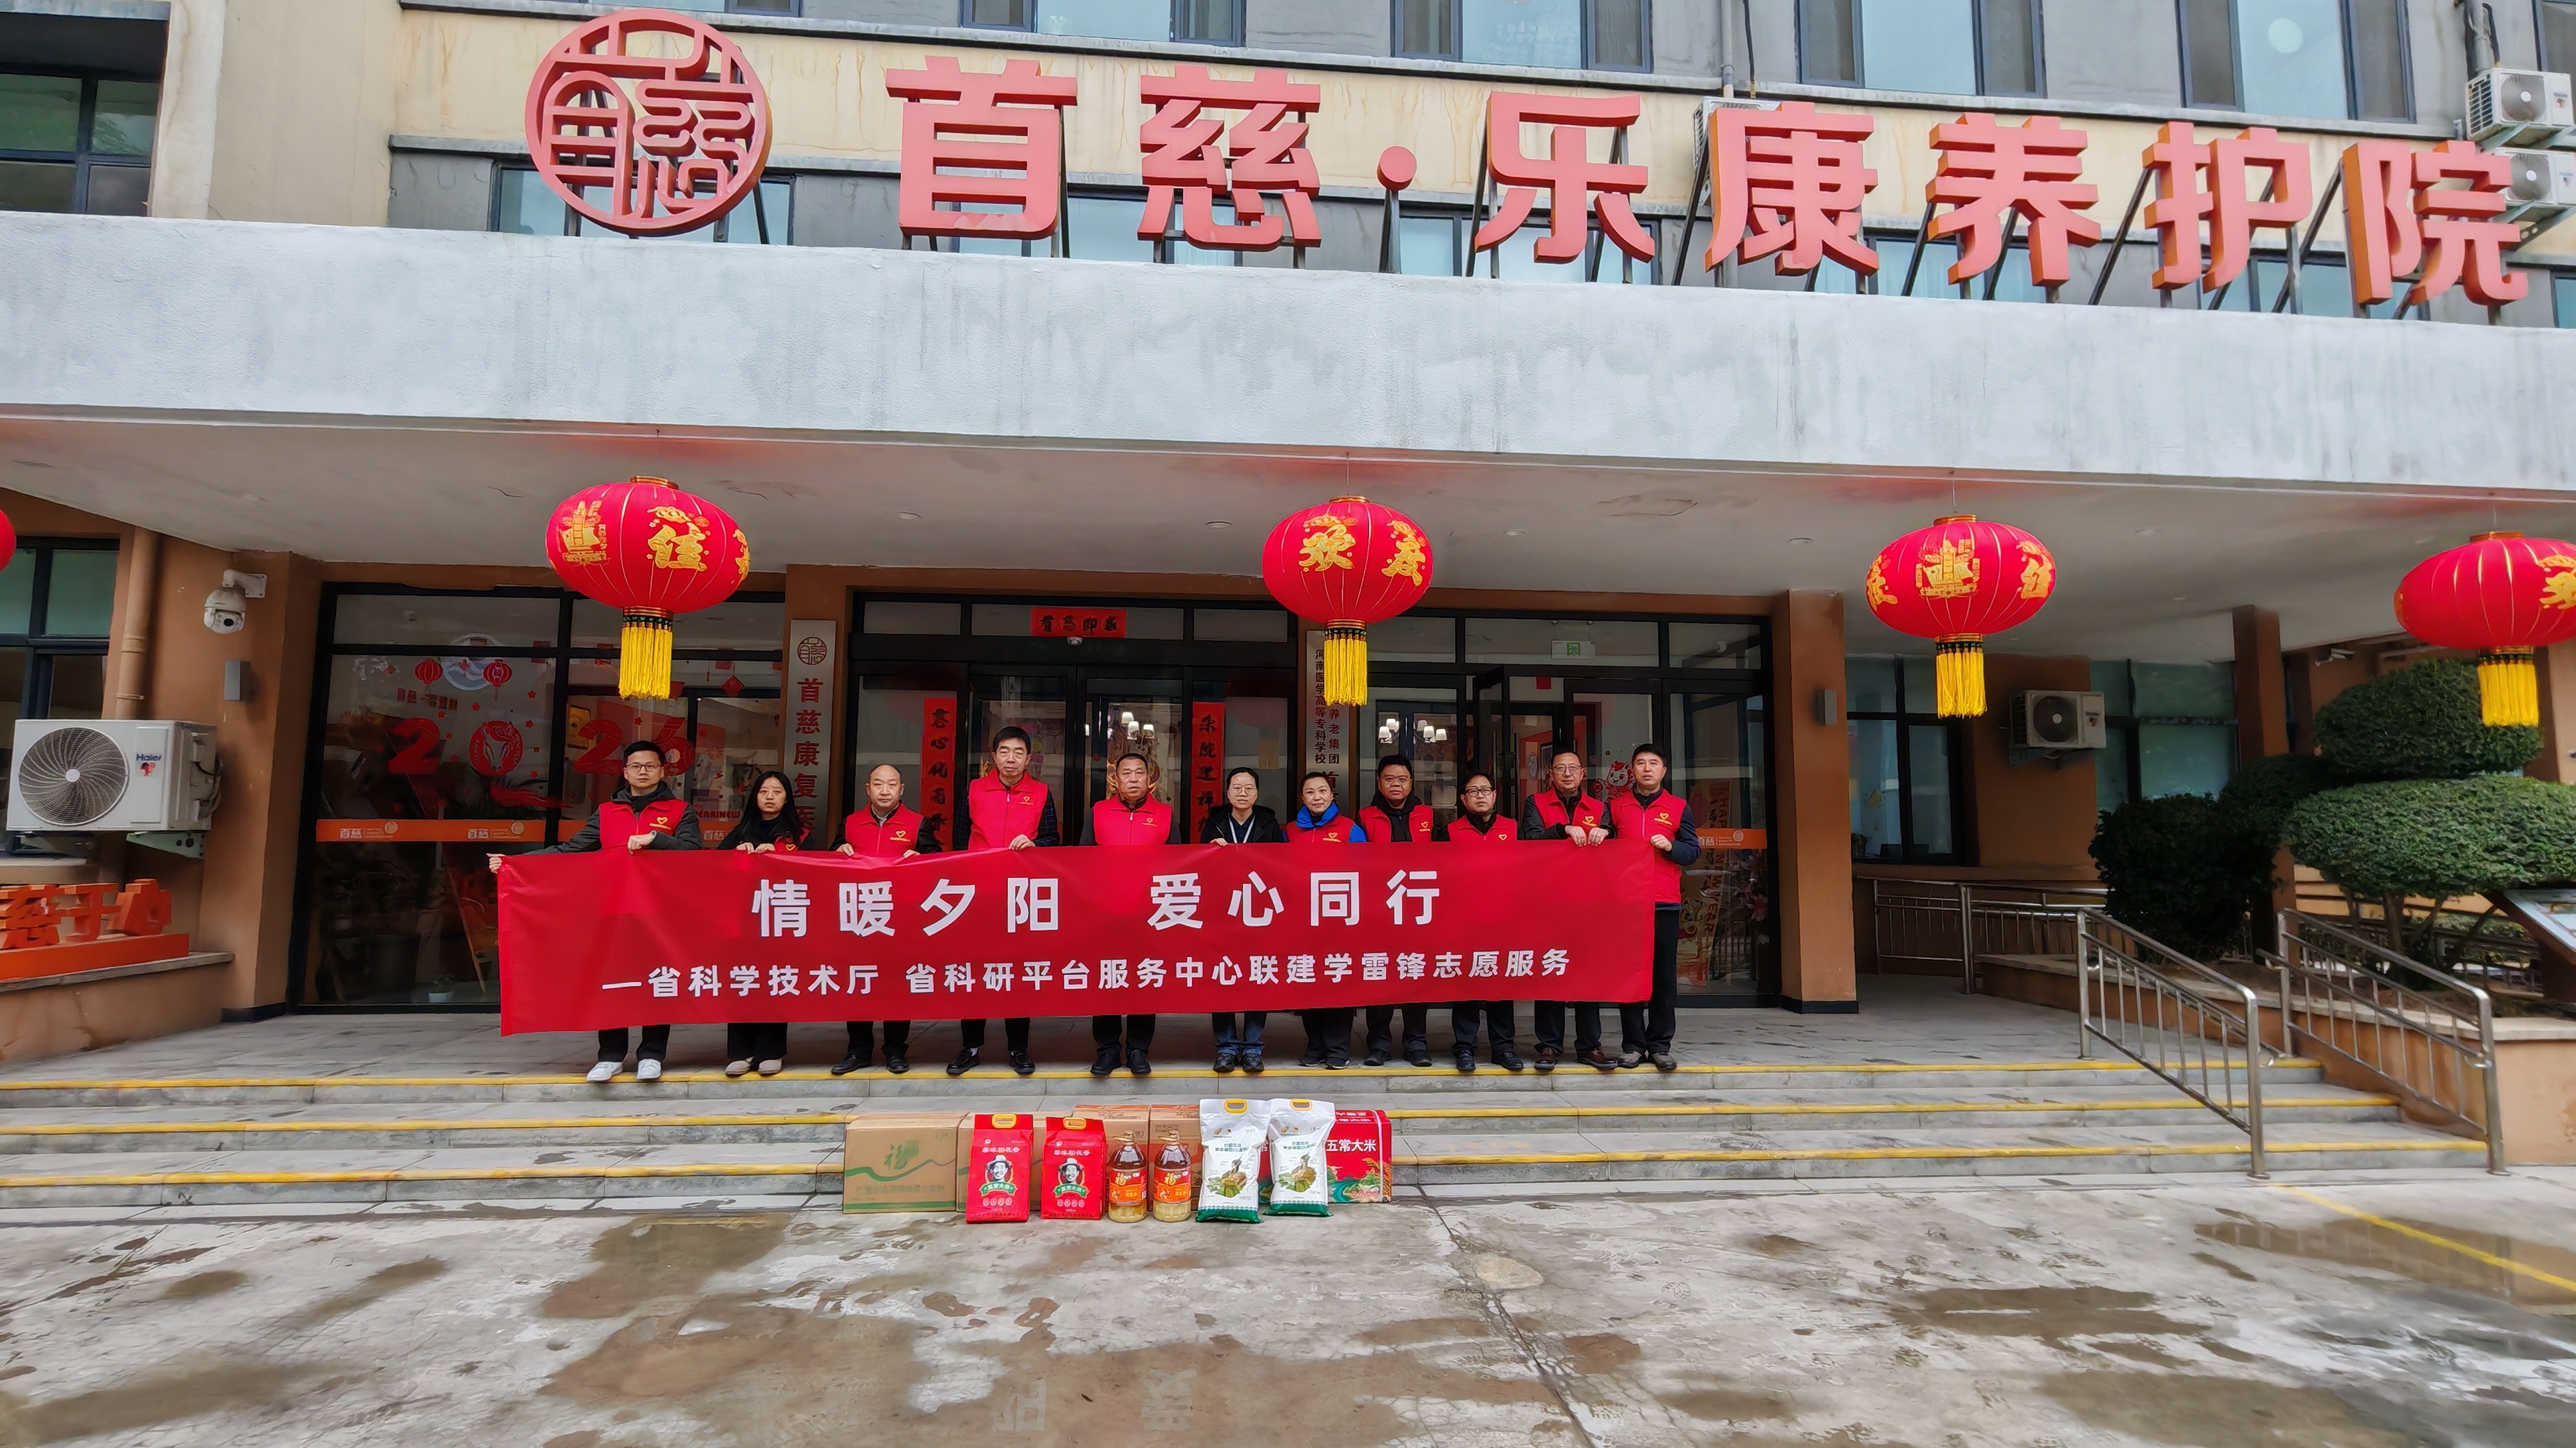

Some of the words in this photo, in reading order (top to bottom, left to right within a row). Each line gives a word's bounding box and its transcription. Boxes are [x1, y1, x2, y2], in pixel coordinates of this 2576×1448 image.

[885, 55, 2529, 307] 首慈·乐康养护院
[1328, 701, 1340, 765] 养老集团
[752, 877, 1060, 938] 情暖夕阳
[1146, 869, 1441, 931] 爱心同行
[905, 948, 1571, 995] 省科研平台服务中心联建学雷锋志愿服务
[1325, 1138, 1377, 1152] 五常大米
[1115, 1172, 1126, 1186] 福
[1164, 1172, 1177, 1186] 福
